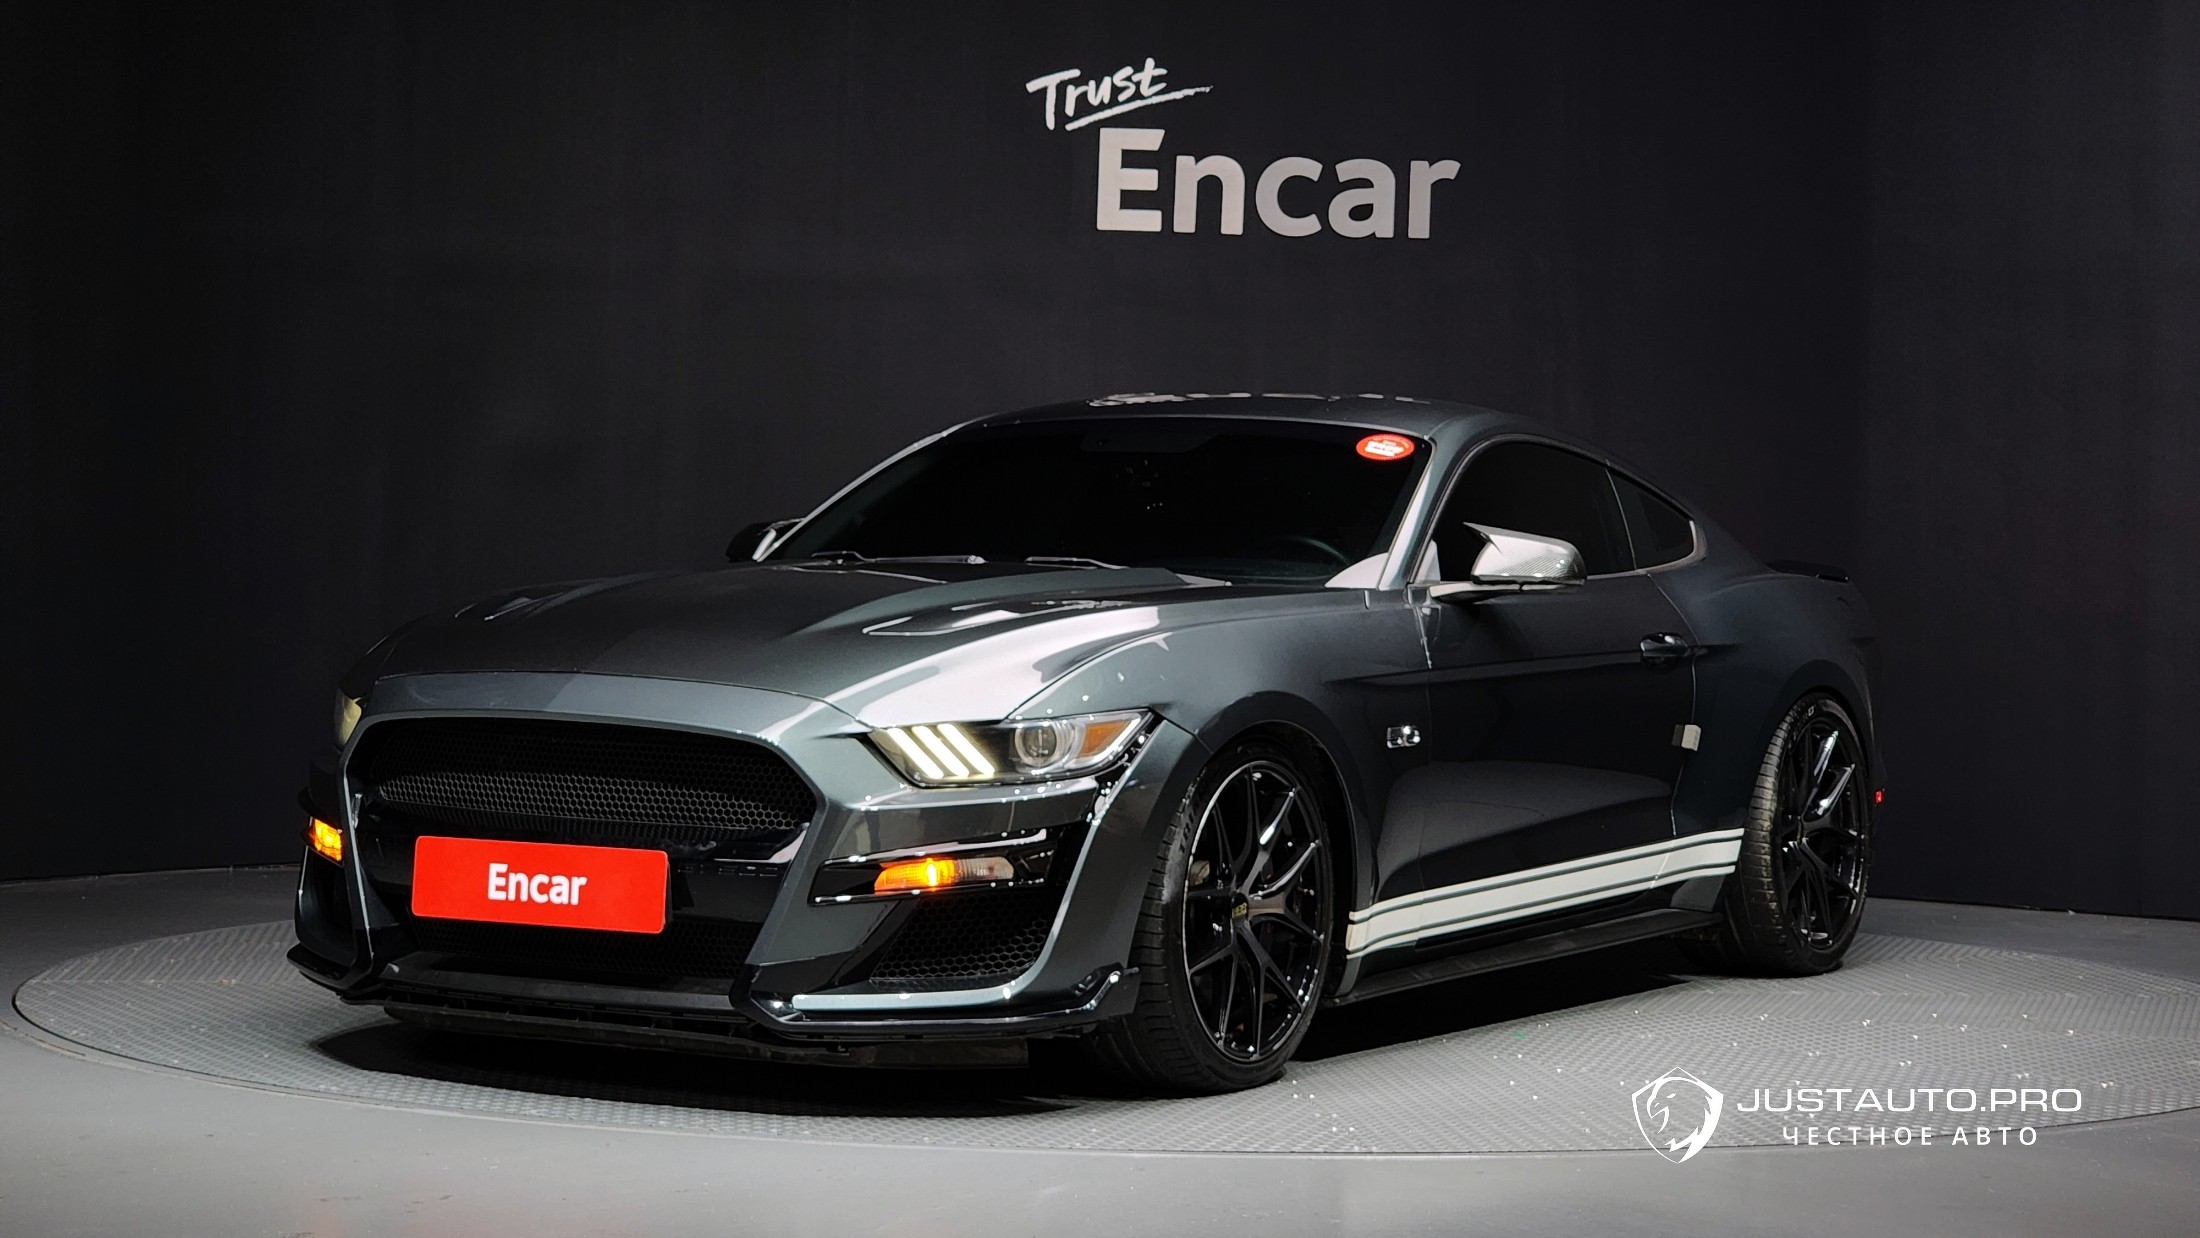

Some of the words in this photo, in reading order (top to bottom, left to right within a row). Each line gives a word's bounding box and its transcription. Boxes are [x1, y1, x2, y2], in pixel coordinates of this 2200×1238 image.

[1025, 57, 1168, 130] Trust
[1096, 127, 1461, 239] Encar
[487, 862, 588, 906] Encar
